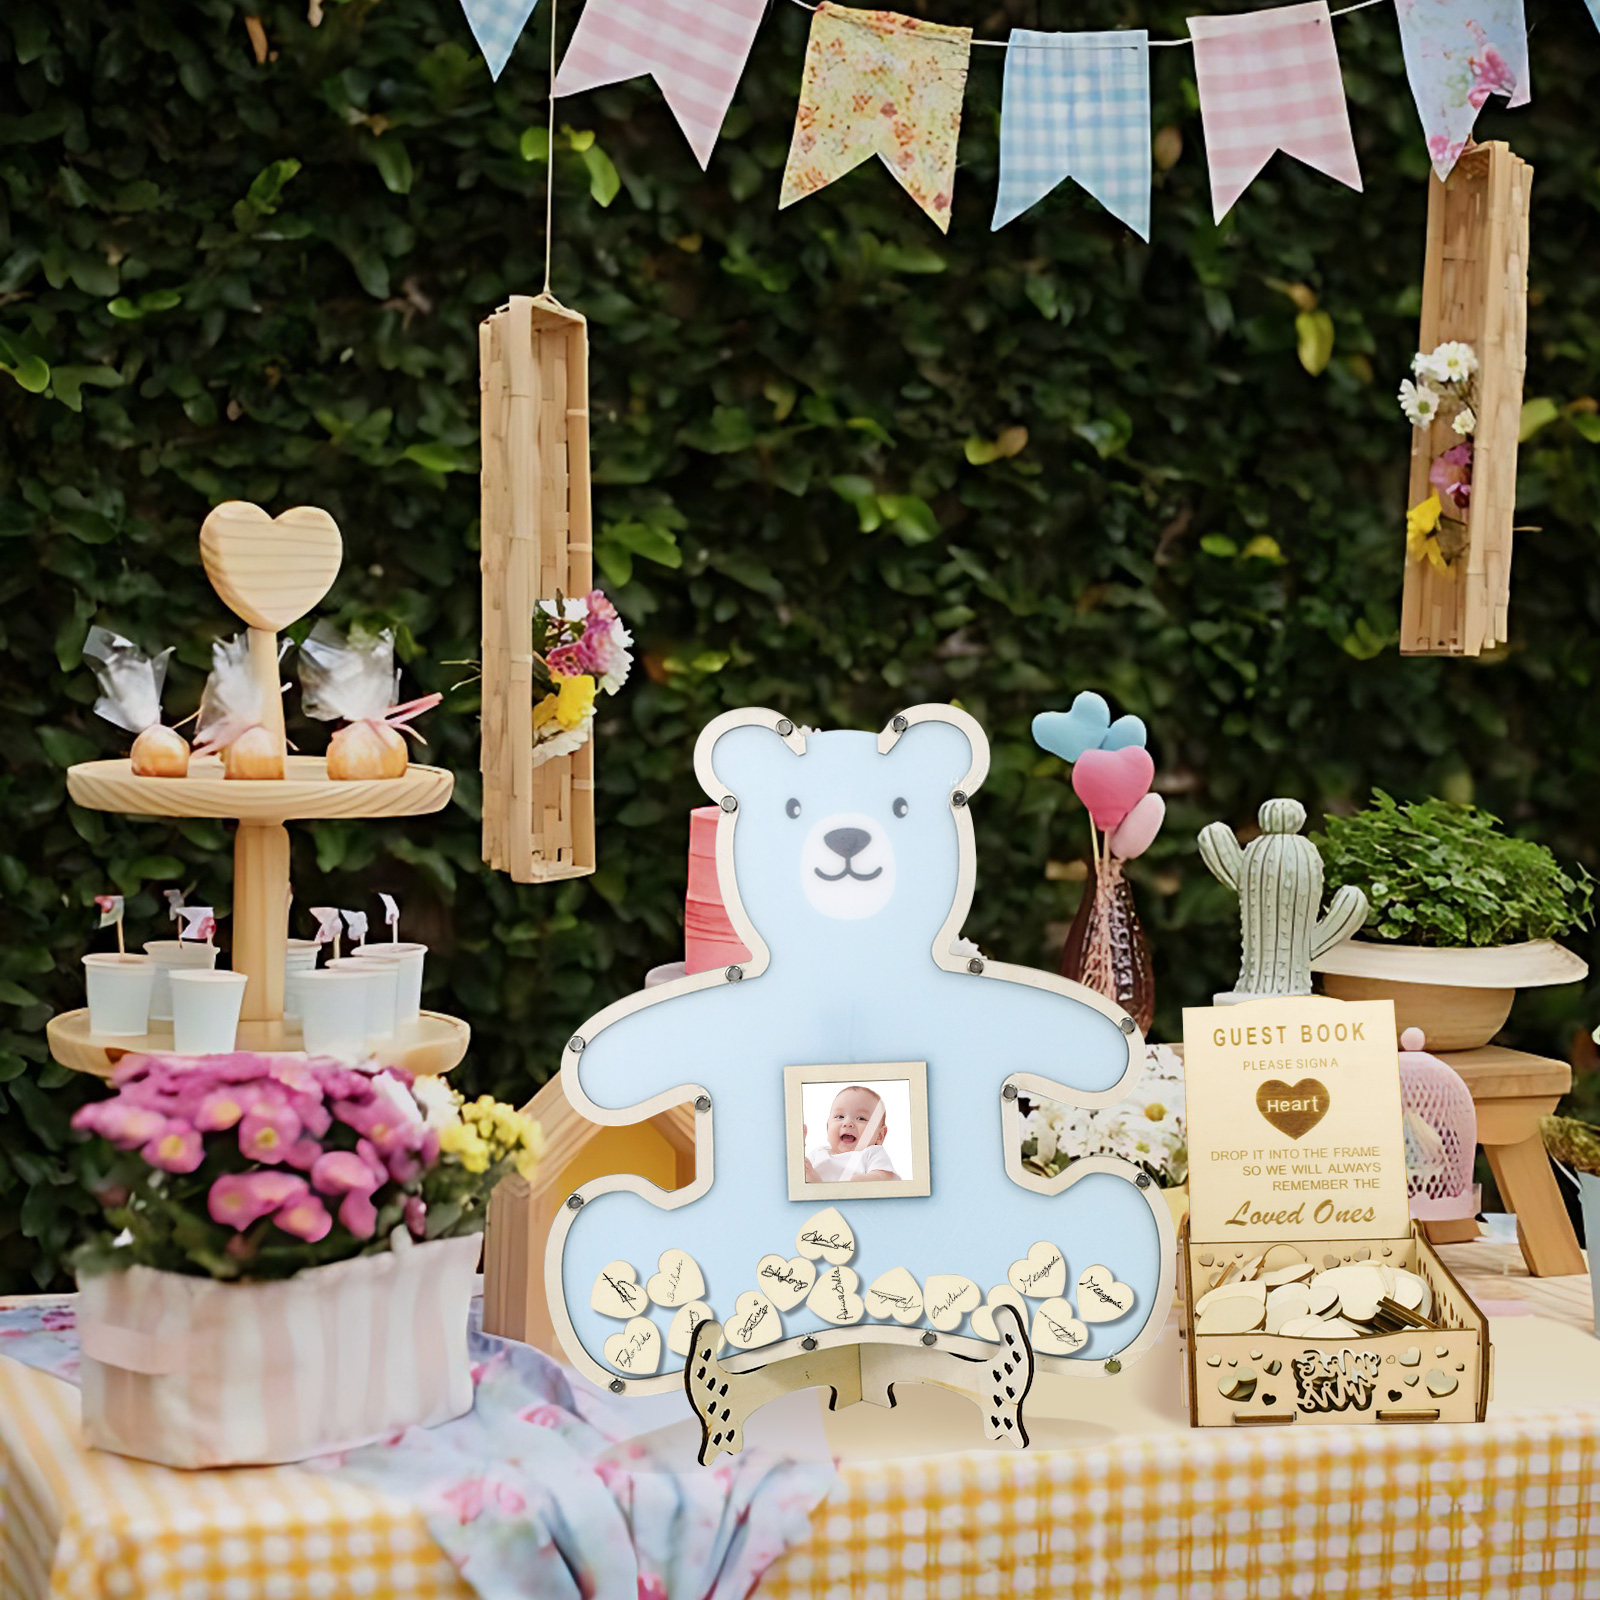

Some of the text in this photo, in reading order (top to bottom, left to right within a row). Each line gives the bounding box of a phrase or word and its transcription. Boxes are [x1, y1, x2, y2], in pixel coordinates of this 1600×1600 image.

[1213, 1022, 1366, 1047] GUEST BOOK
[1243, 1058, 1339, 1071] PLEASE SIGN A
[1266, 1095, 1319, 1113] Heart
[1211, 1146, 1380, 1161] DROP IT INTO THE FRAME
[1242, 1162, 1381, 1176] SO WE WILL ALWAYS
[1272, 1178, 1380, 1191] REMEMBER THE
[1224, 1199, 1377, 1226] Loved Ones
